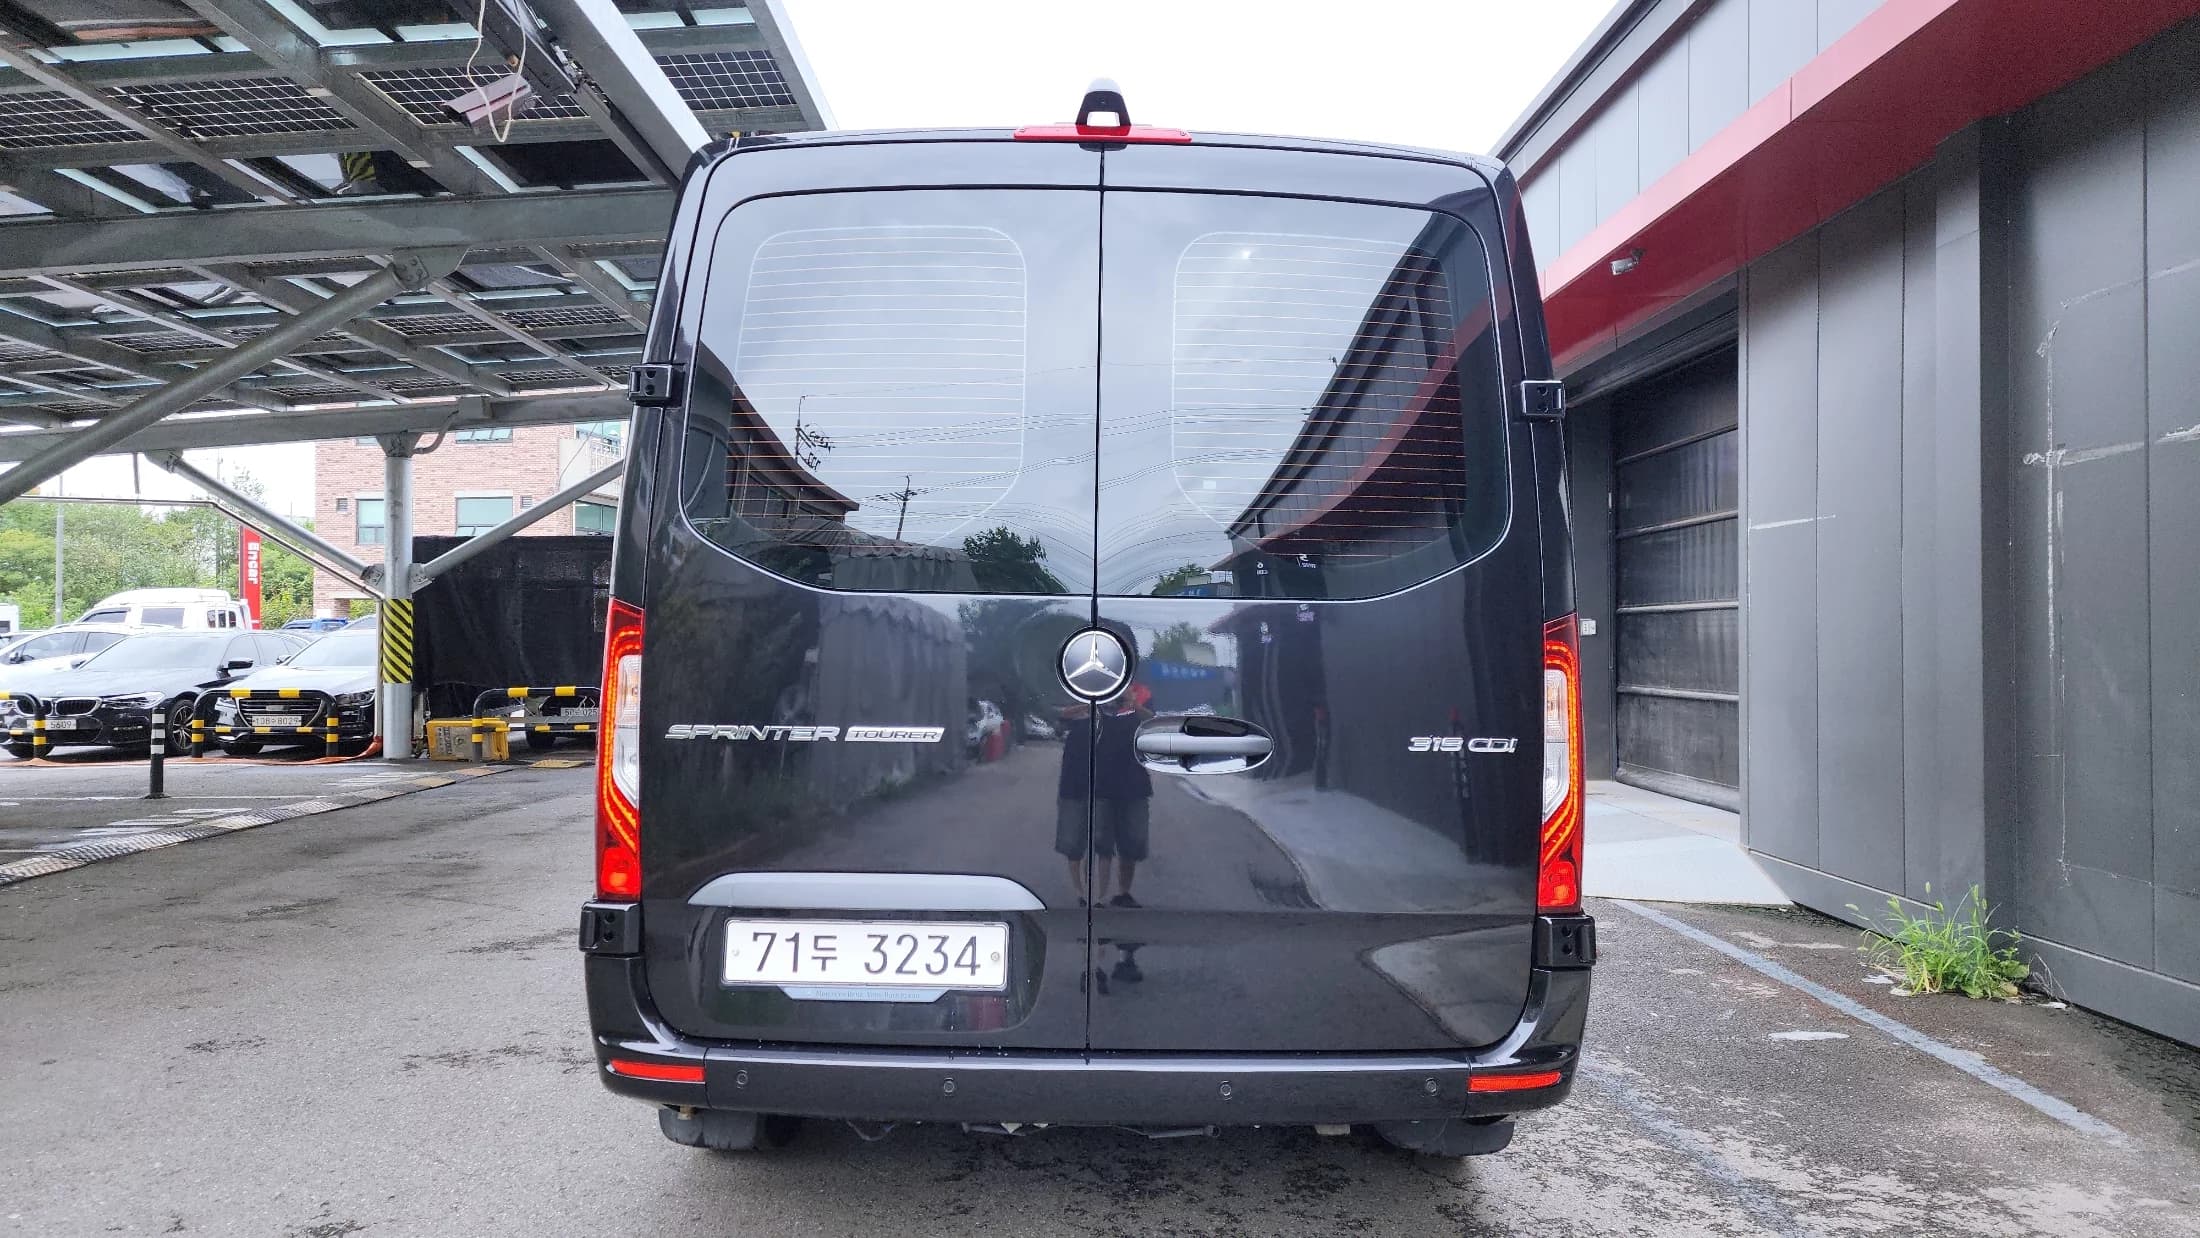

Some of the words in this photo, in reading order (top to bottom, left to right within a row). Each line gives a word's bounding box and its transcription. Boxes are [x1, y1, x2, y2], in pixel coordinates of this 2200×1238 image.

[664, 724, 841, 742] SPRINTER
[850, 728, 941, 741] TOURER
[1467, 738, 1518, 753] CDI
[751, 931, 839, 974] 71두
[863, 933, 982, 977] 3234
